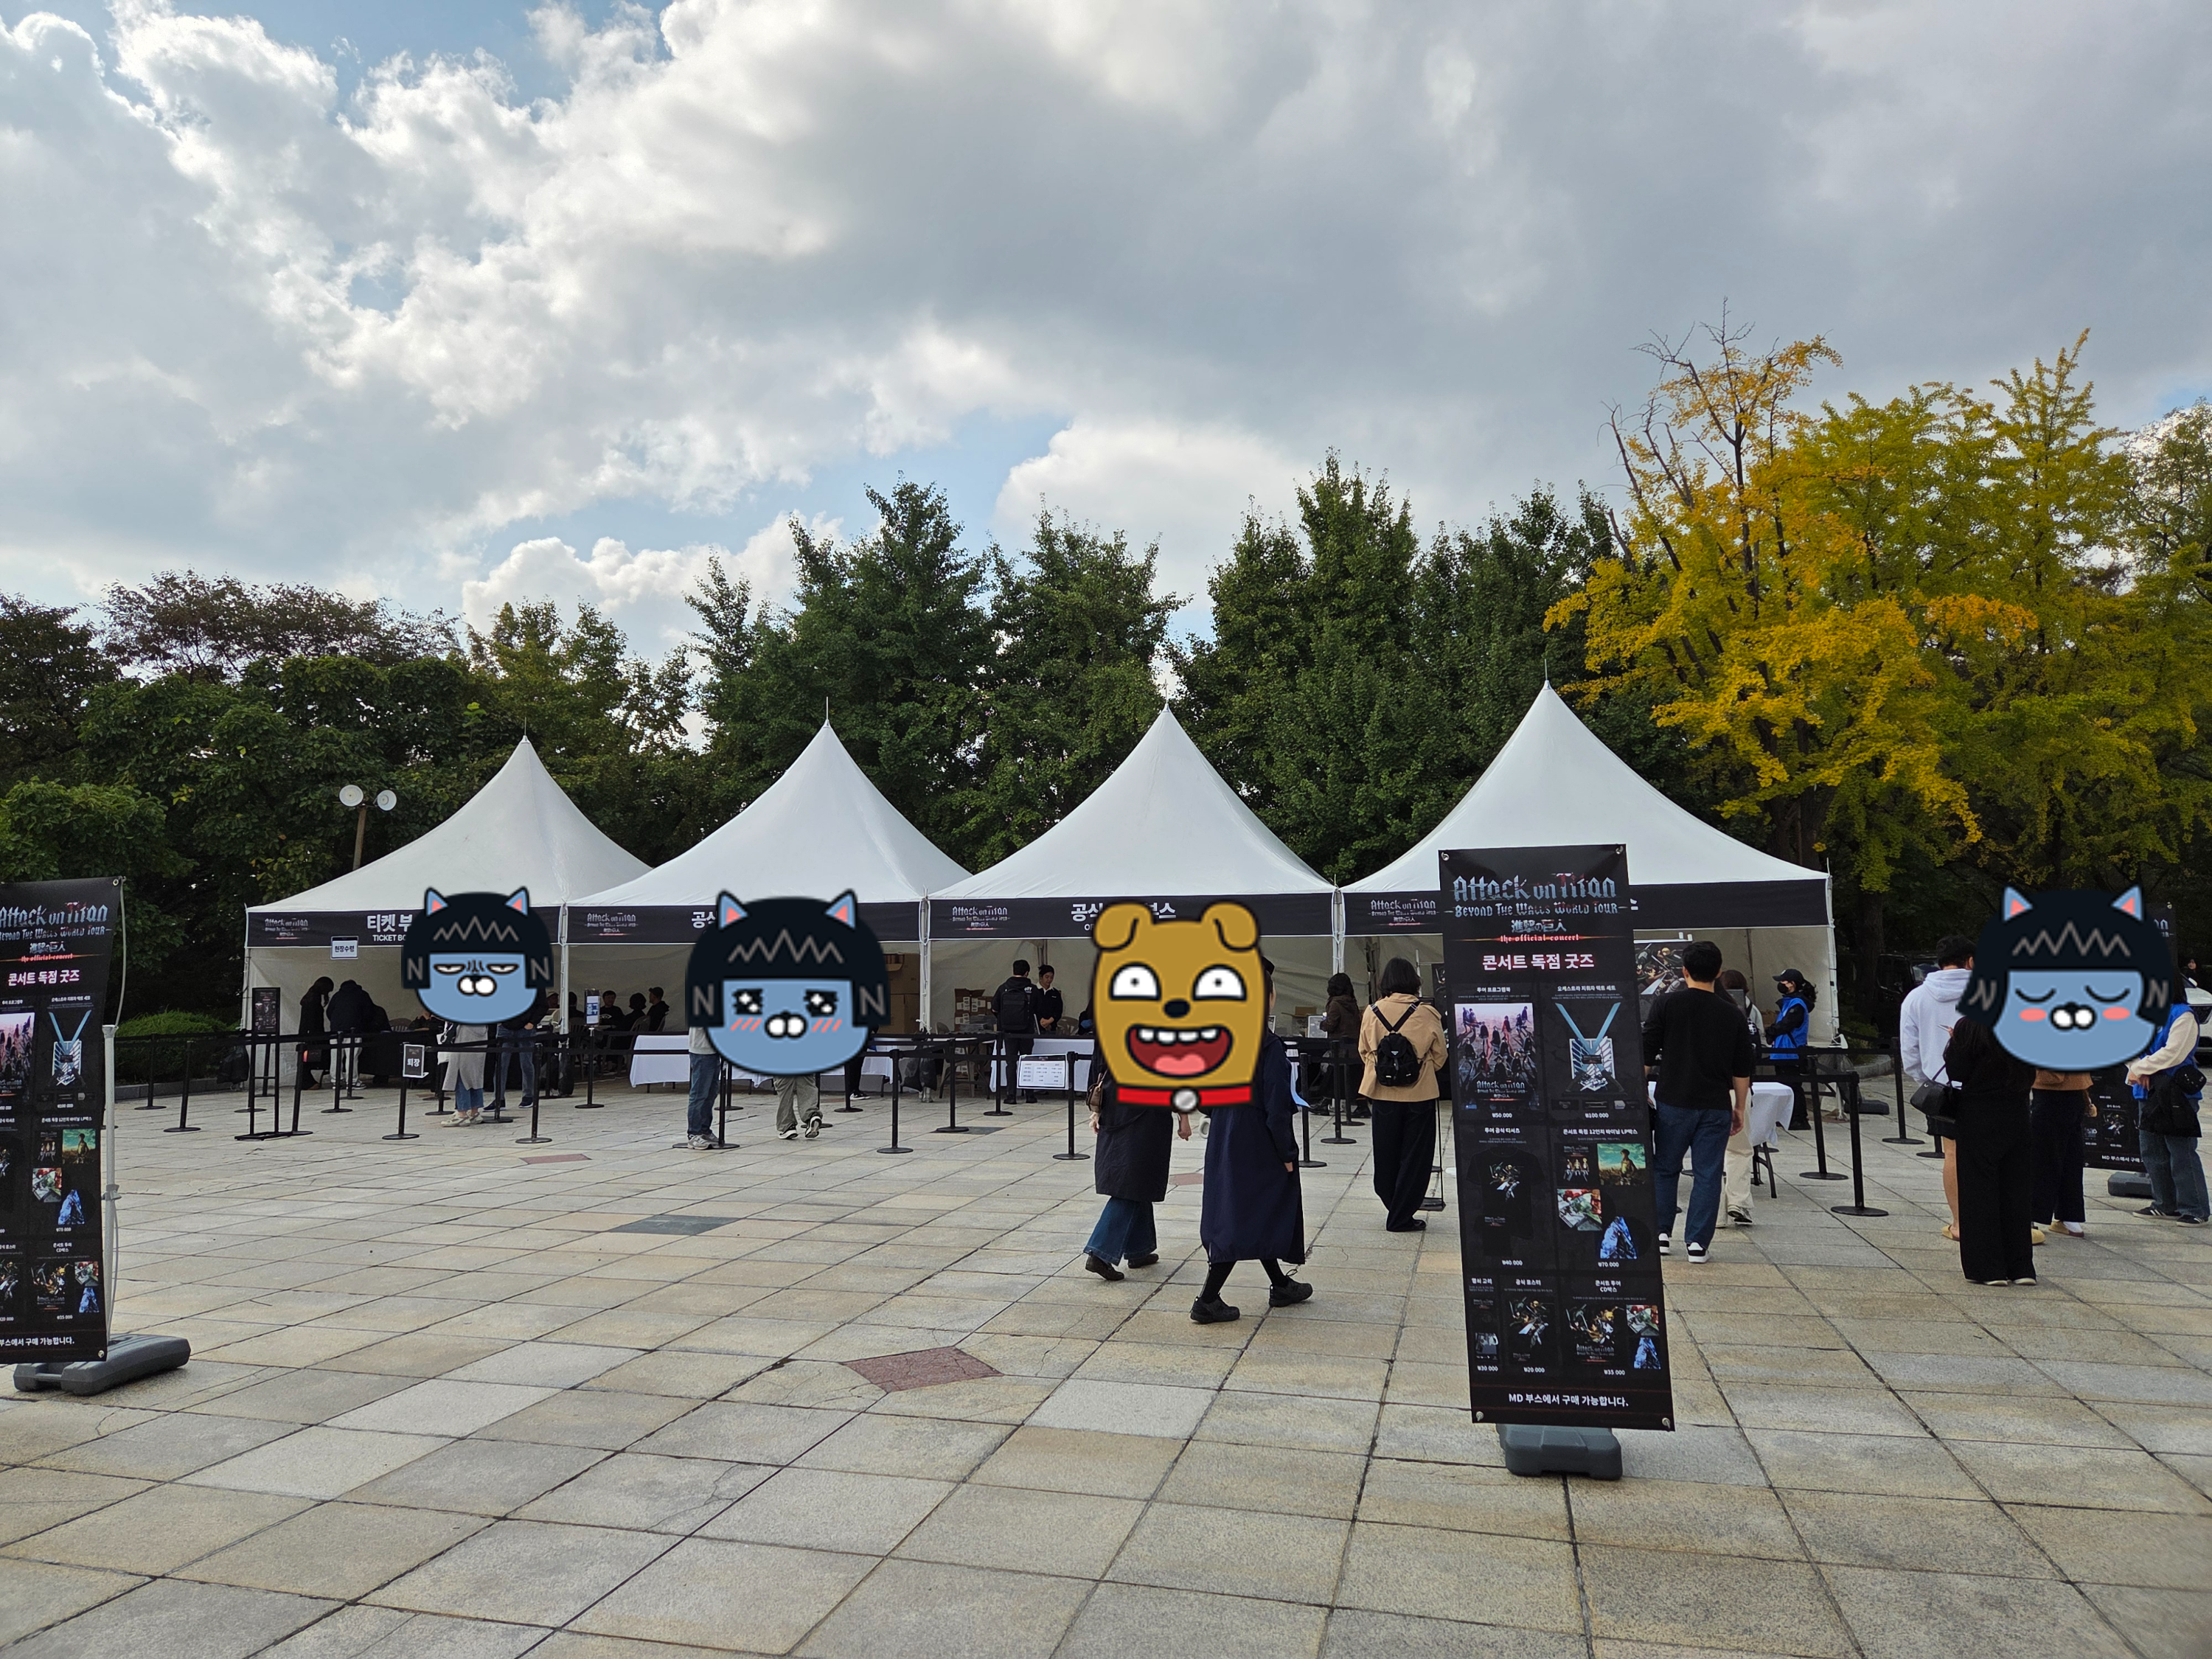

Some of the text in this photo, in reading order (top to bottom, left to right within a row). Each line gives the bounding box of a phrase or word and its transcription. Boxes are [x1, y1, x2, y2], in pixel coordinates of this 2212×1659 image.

[1453, 873, 1616, 902] Attack on Titan
[953, 906, 978, 916] Attack
[987, 905, 1007, 915] Titan
[1371, 900, 1401, 910] Attack
[1411, 899, 1436, 909] Titan
[0, 901, 108, 928] Attack on Titan
[367, 914, 413, 932] 티켓 부
[1500, 933, 1579, 944] the official concert
[1483, 953, 1595, 970] 콘서트 독점 굿즈
[8, 970, 80, 986] 콘서트 독점 굿즈
[407, 1058, 420, 1067] 퇴장
[25, 1338, 38, 1346] 구매
[40, 1336, 74, 1346] 가능합니다.
[1509, 1393, 1629, 1407] MD 부스에서 구매 가능합니다.
